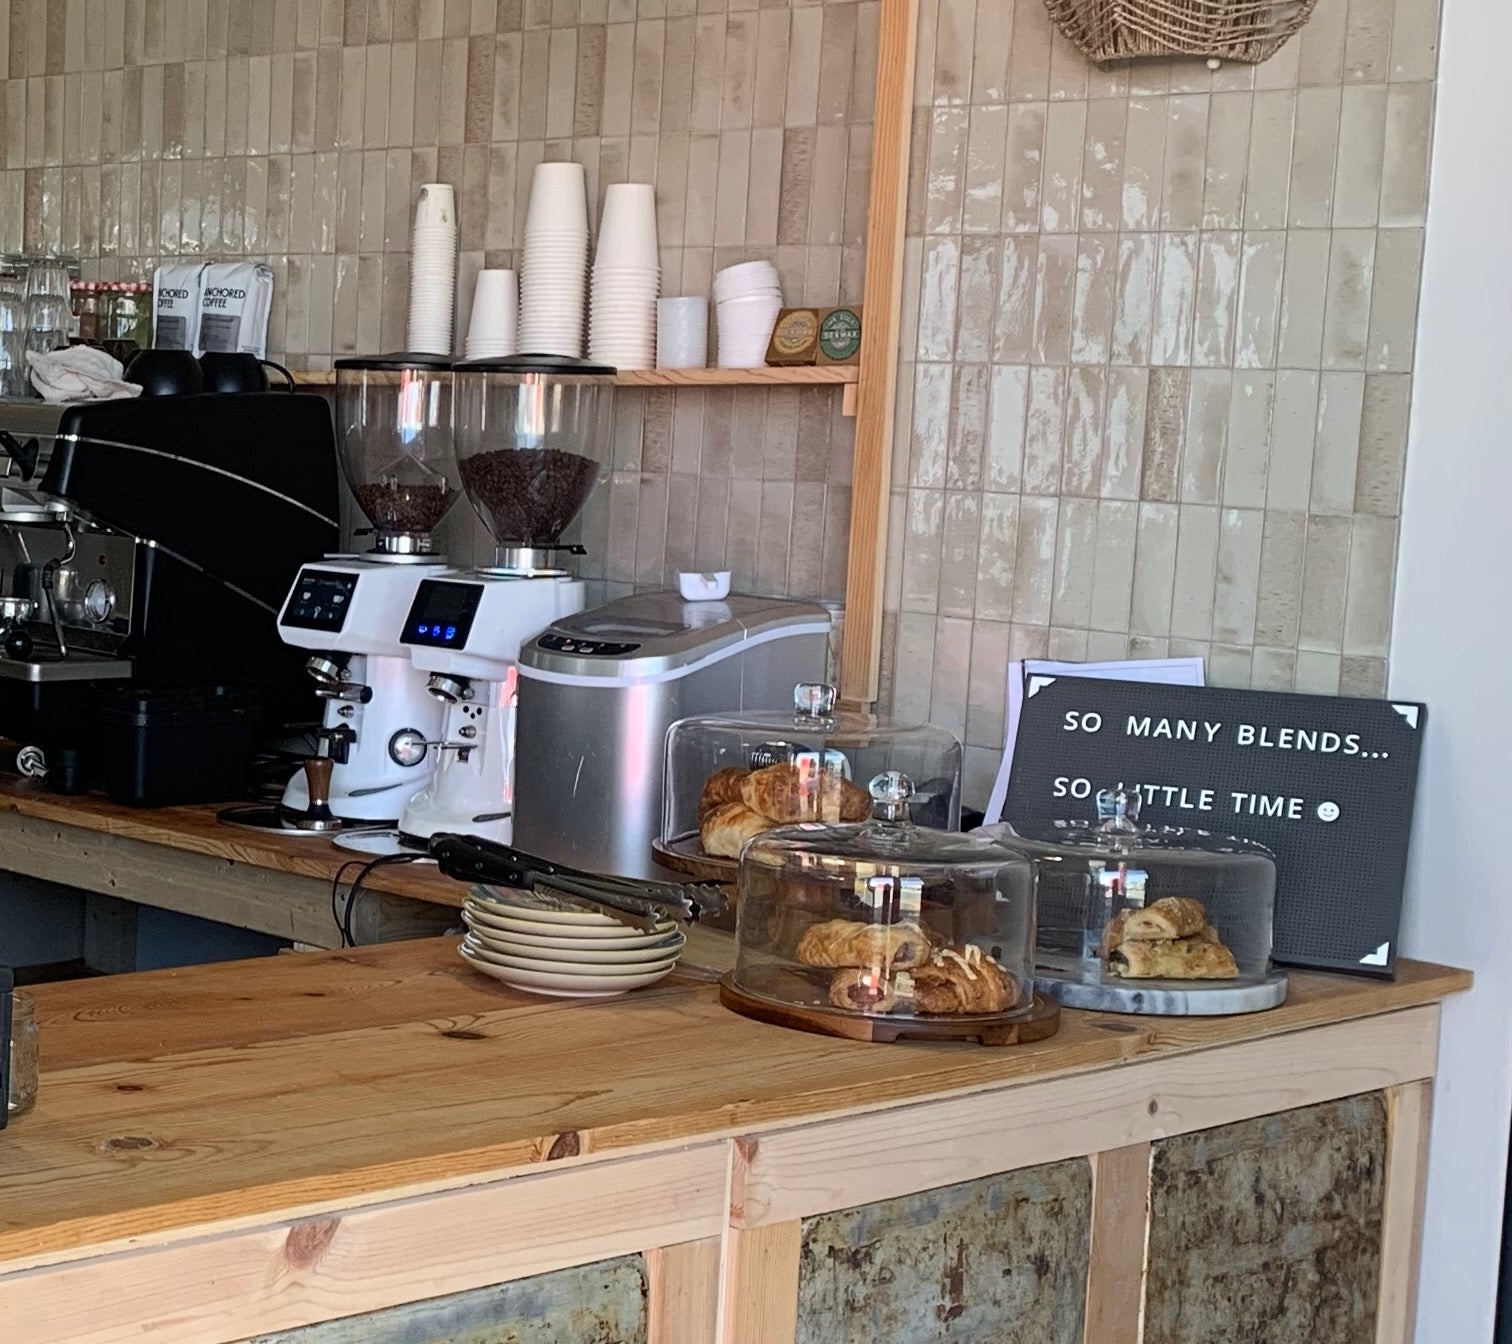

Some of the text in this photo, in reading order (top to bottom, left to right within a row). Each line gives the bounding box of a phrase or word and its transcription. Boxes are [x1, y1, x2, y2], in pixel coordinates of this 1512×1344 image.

[158, 288, 189, 299] NCHORED
[204, 287, 246, 299] ANCHORED
[157, 298, 174, 308] OFFEE
[202, 297, 227, 308] COFFEE
[1063, 711, 1389, 759] SO MANY BLENDS...
[1053, 776, 1304, 819] SO TTLE TIME
